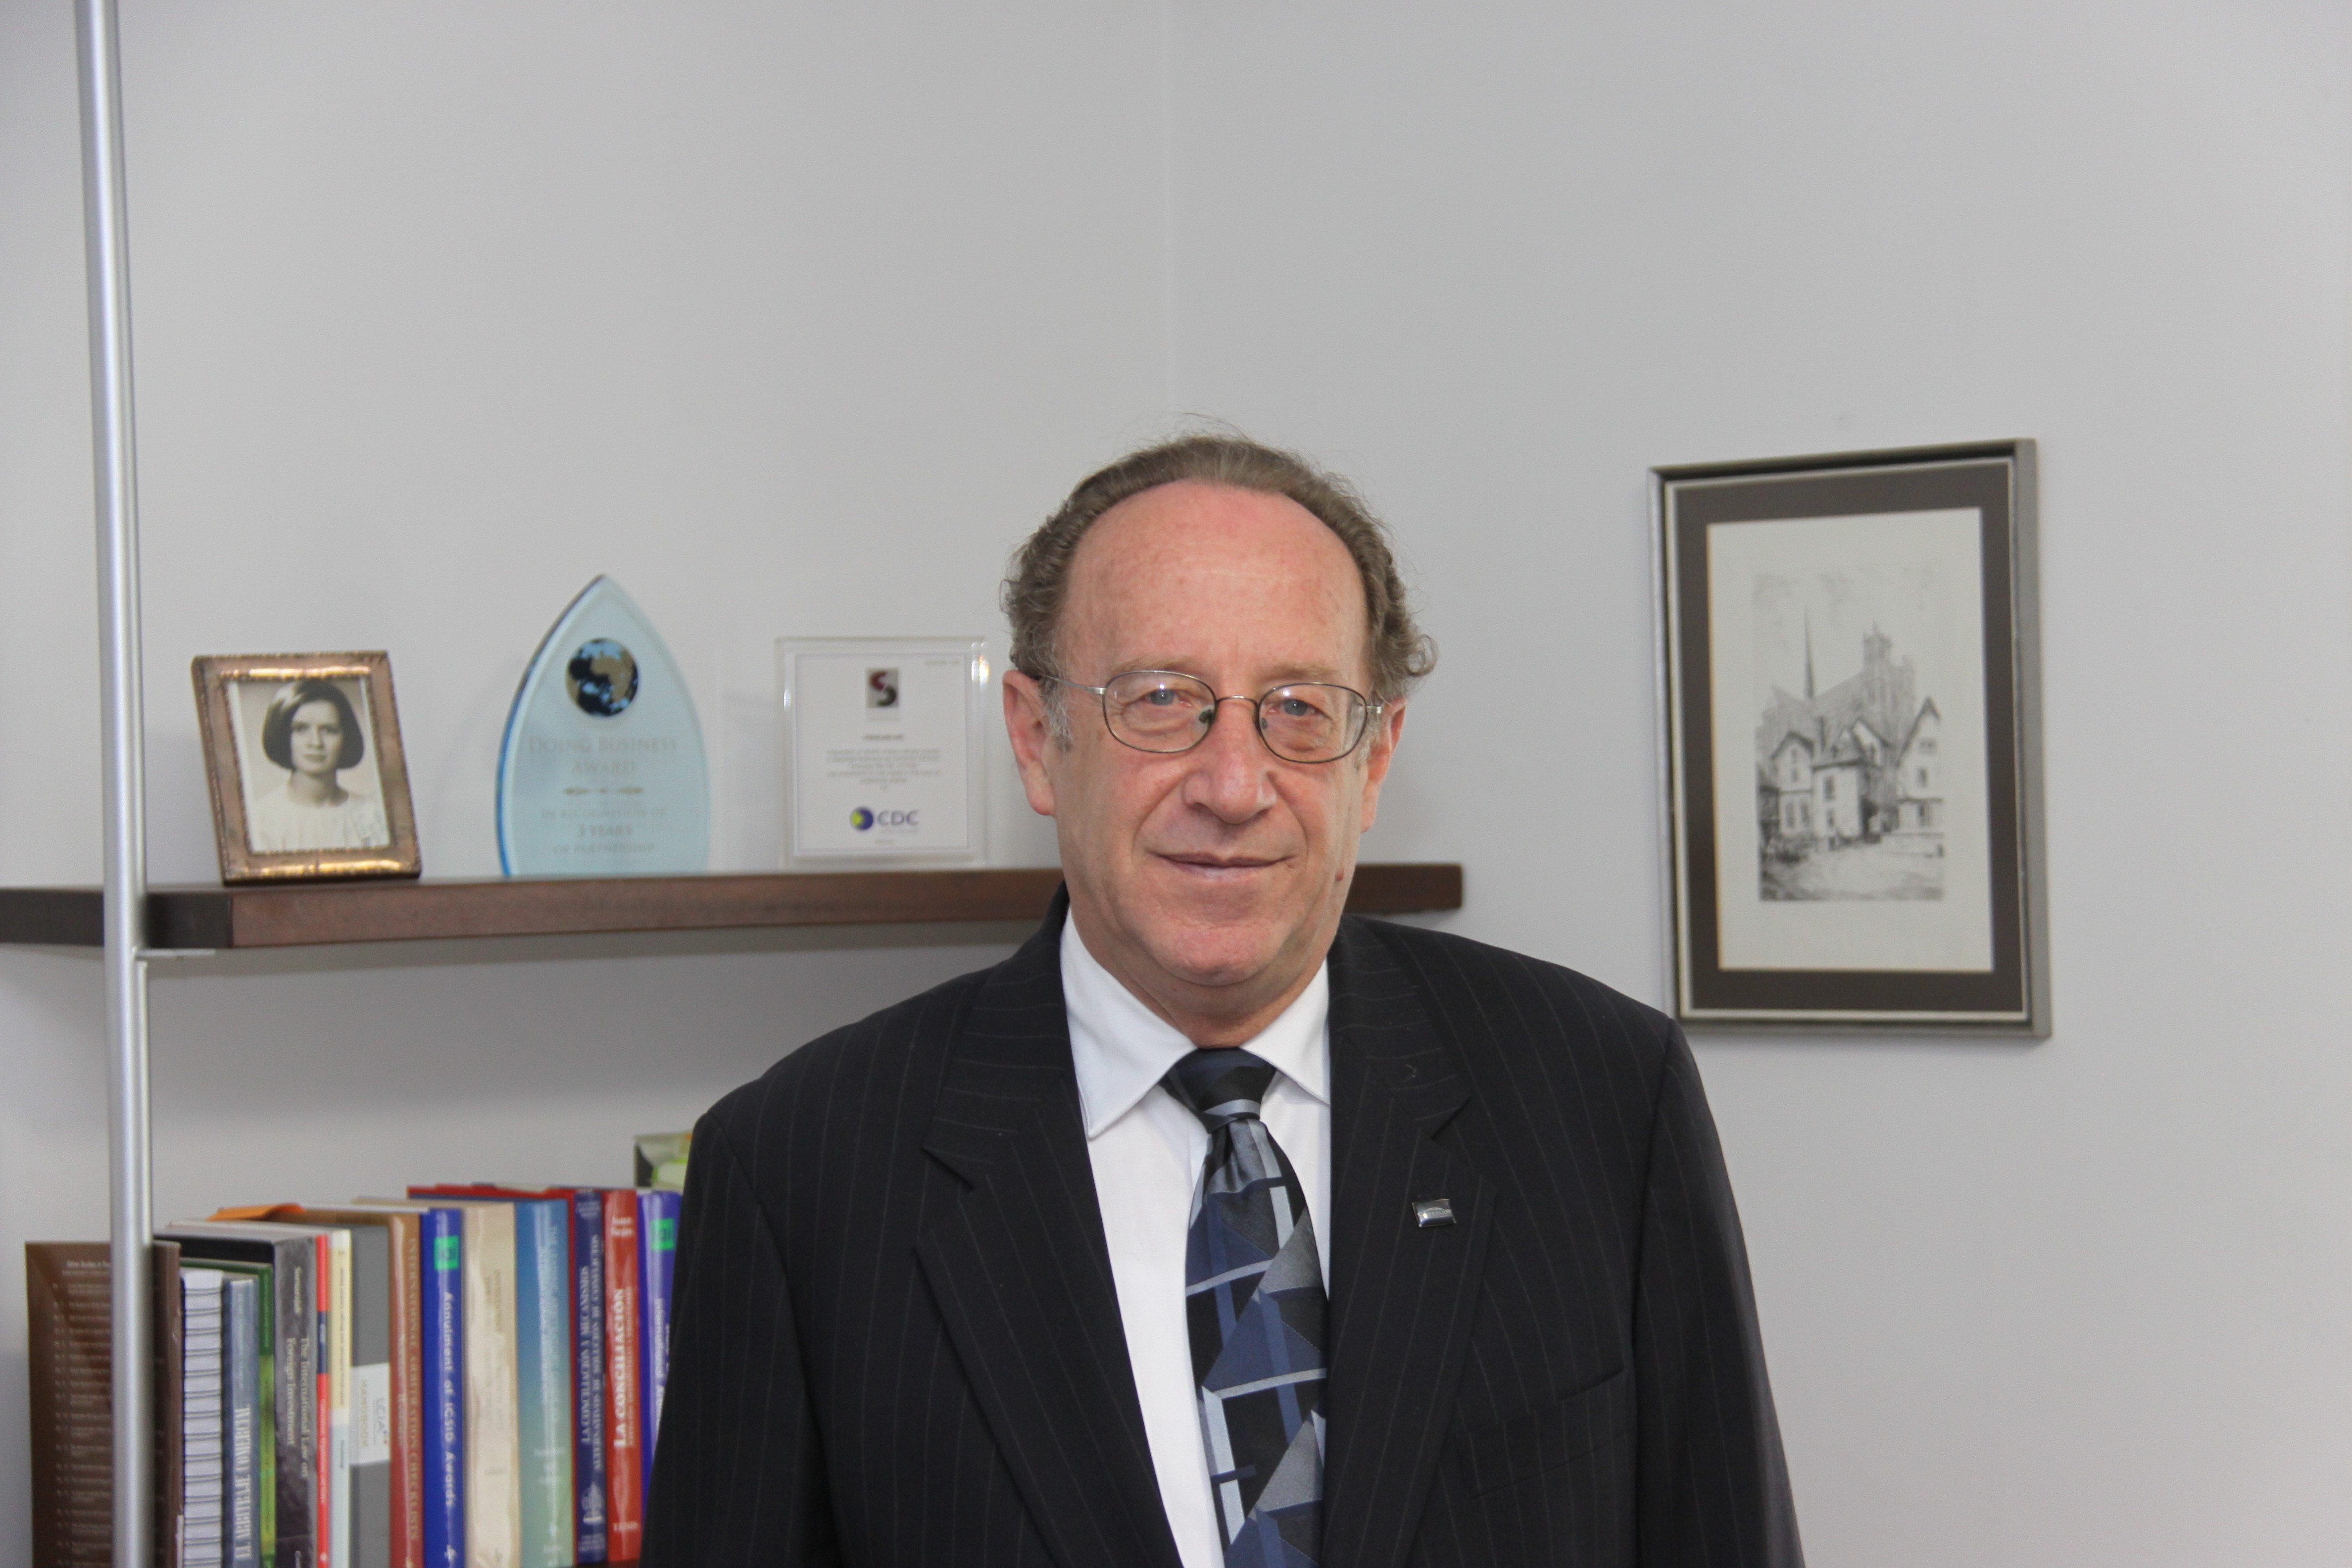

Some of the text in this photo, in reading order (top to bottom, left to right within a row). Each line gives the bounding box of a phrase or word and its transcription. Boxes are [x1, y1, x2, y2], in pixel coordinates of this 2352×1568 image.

[529, 736, 678, 753] DOING BUSINESS
[572, 760, 636, 774] AWARD
[877, 809, 919, 826] CDC
[579, 1266, 590, 1336] MECANISMOS
[590, 1234, 600, 1301] CONFLICTOS
[591, 1305, 600, 1318] DE
[654, 1298, 664, 1378] International
[285, 1337, 297, 1446] Foreign Investment
[409, 1237, 419, 1540] INTERNATIONAL ARBITRATION CHECKLISTS
[444, 1291, 455, 1507] Annulment of ICSID Awards
[578, 1348, 590, 1426] CONCILIACIÓN
[592, 1378, 601, 1391] DE
[611, 1288, 627, 1448] LA CONCILIACIÓN
[235, 1404, 251, 1472] COMERCIAL
[300, 1337, 310, 1477] The International Law on
[581, 1428, 590, 1444] LA
[592, 1393, 603, 1471] ALTERNATIVOS
[235, 1474, 251, 1540] ARBITRAJE
